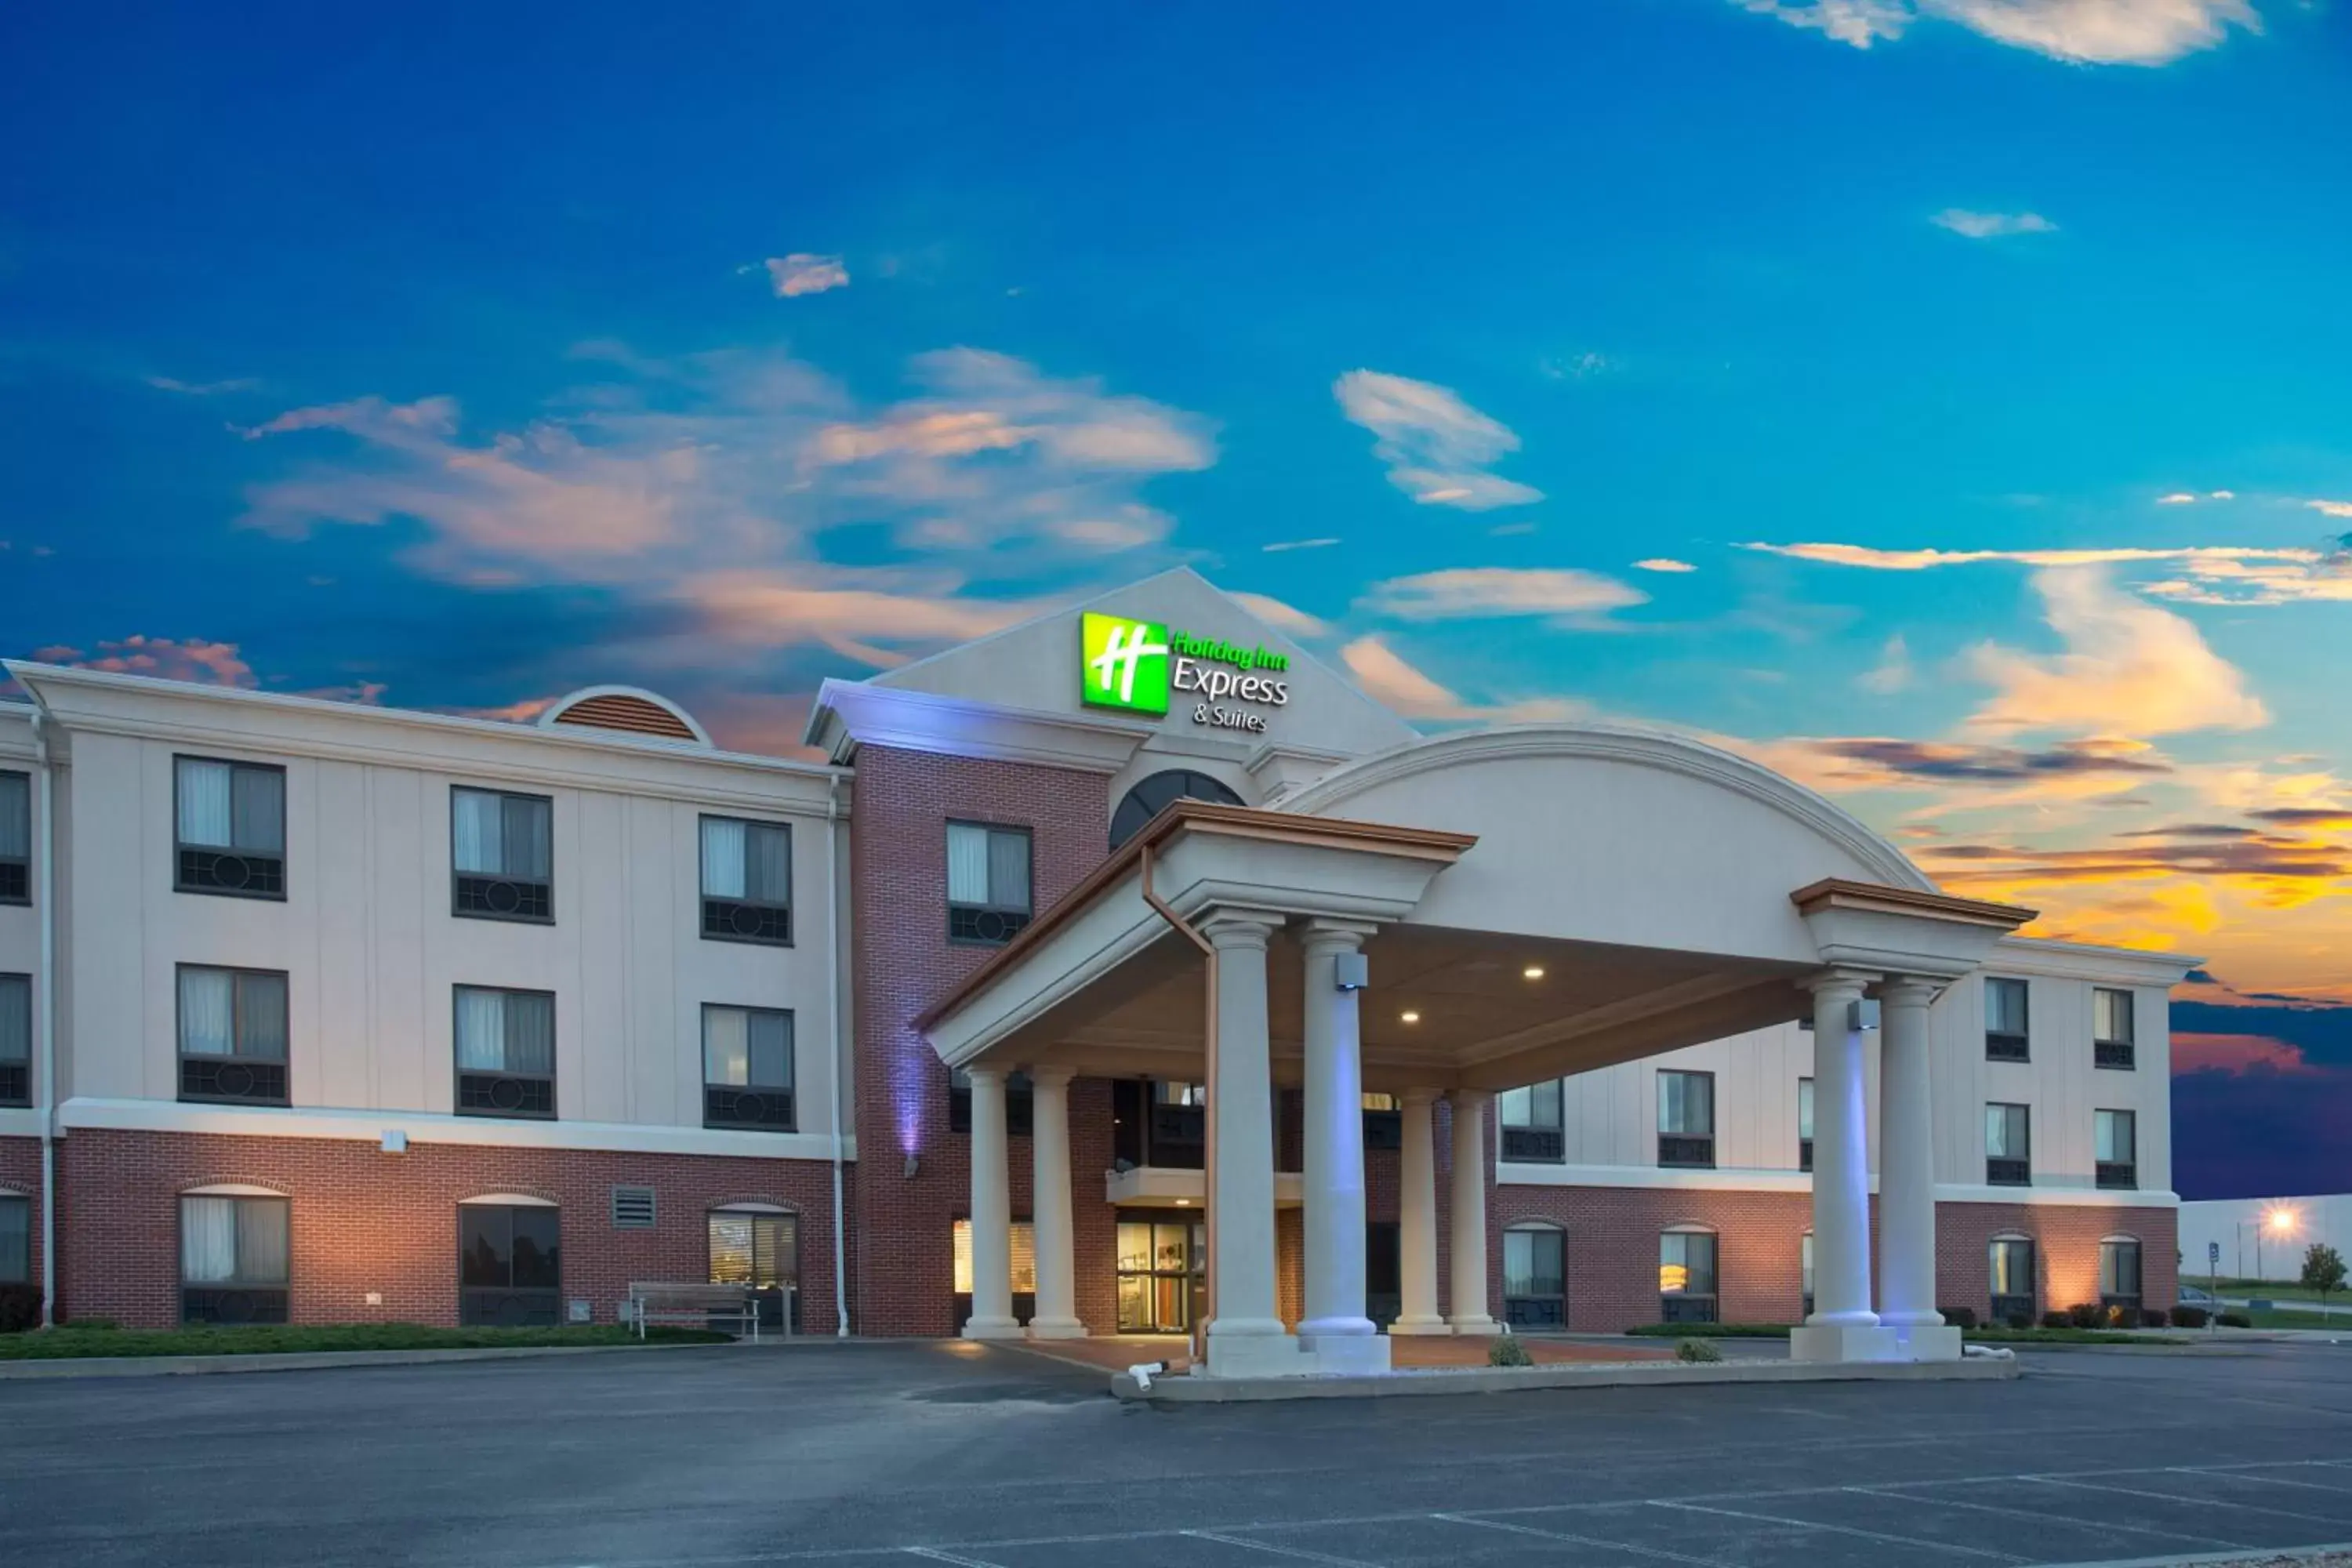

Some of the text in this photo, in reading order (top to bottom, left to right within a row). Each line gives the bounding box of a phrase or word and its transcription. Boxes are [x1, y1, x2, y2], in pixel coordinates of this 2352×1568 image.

[1173, 630, 1290, 671] Holiday Inn
[1173, 657, 1289, 706] Express
[1193, 703, 1268, 732] & Suites
